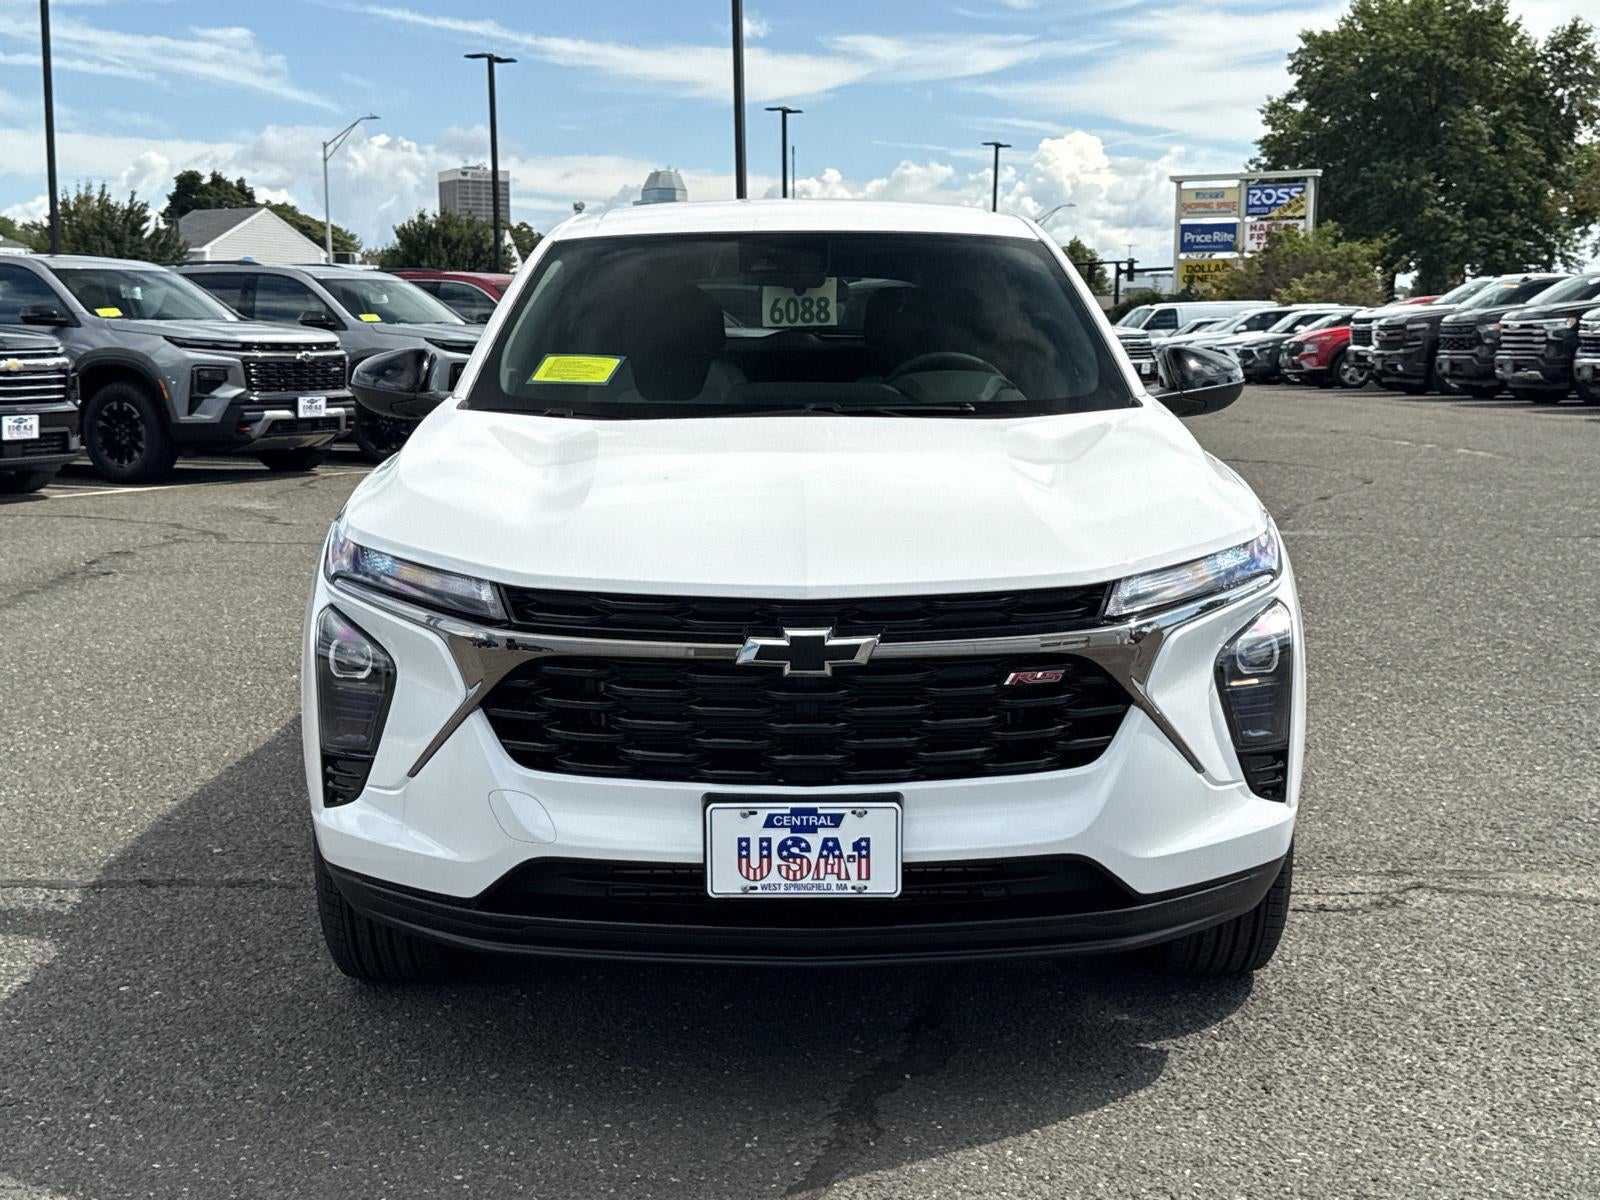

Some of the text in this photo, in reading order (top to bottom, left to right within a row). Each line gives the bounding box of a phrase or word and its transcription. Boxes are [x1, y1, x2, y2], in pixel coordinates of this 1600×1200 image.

[1248, 187, 1304, 206] ROSS
[1184, 231, 1235, 243] Price Rite
[769, 296, 831, 325] 6088
[1003, 670, 1066, 686] RS
[773, 815, 835, 826] CENTRAL
[737, 835, 871, 882] USA-1
[760, 882, 848, 892] WEST SPRINGFIELD, MA
